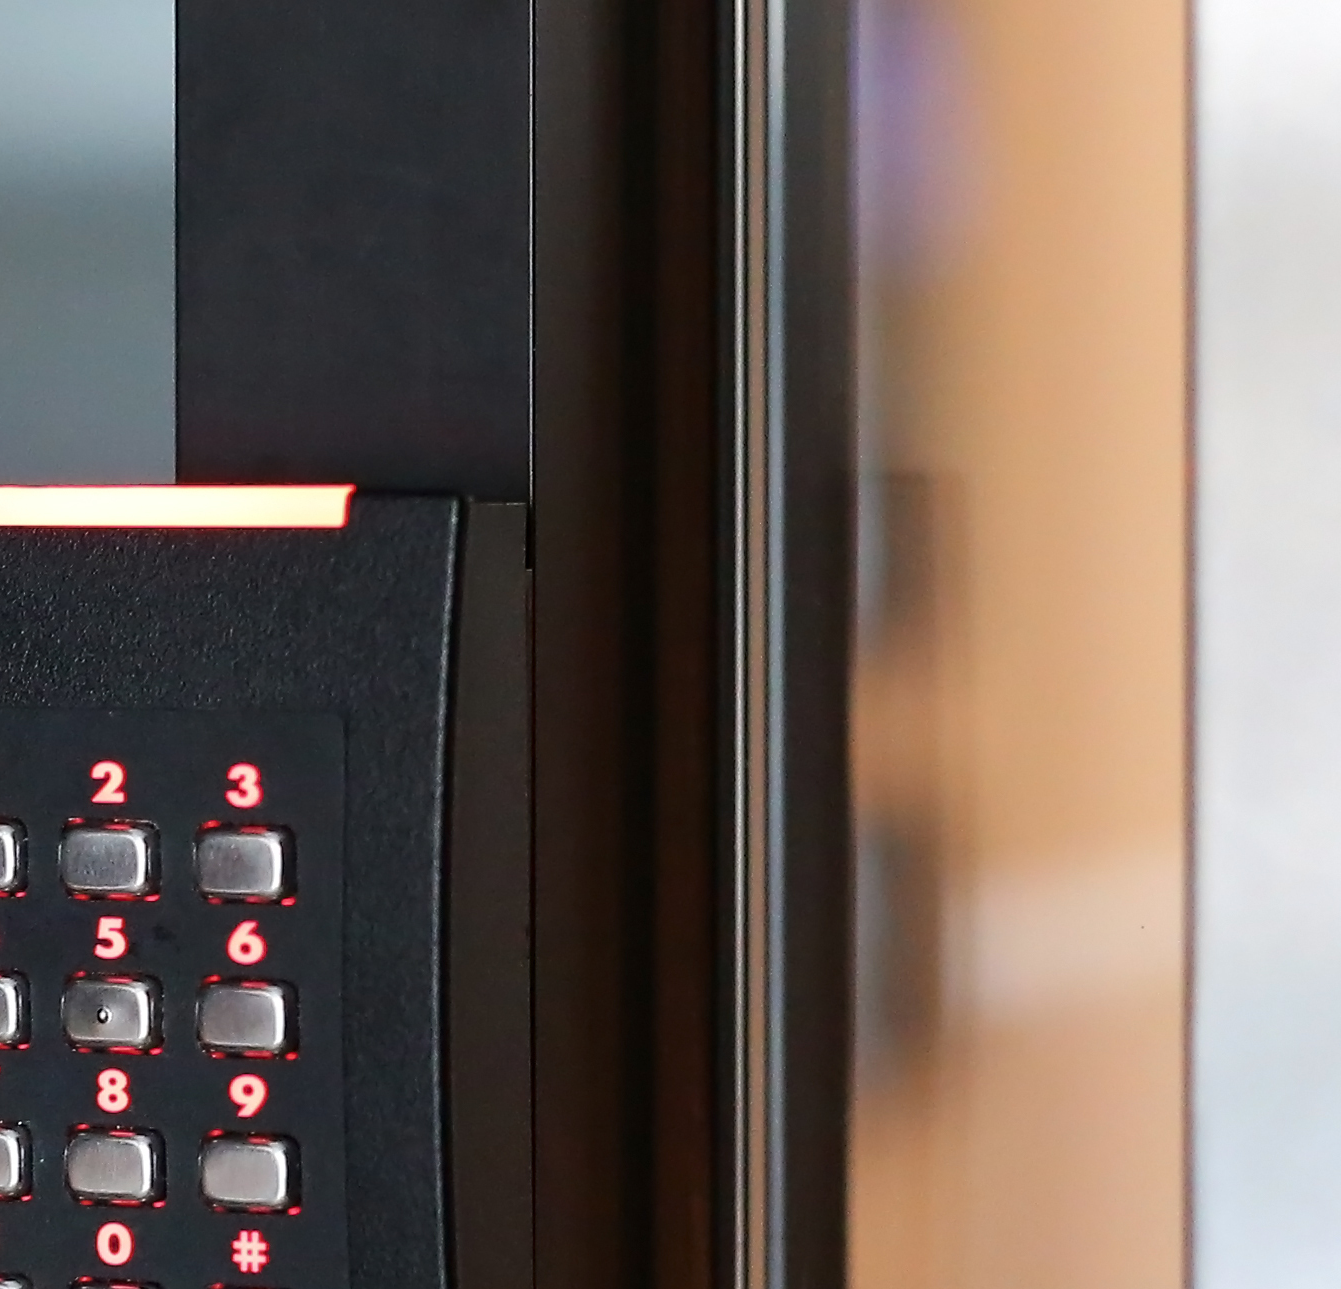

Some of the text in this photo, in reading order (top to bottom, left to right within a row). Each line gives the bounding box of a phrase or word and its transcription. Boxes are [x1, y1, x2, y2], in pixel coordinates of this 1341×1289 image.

[91, 761, 127, 803] 2
[226, 763, 263, 808] 3
[95, 917, 128, 959] 5
[227, 921, 266, 965] 6
[96, 1069, 131, 1113] 8
[229, 1074, 267, 1117] 9
[96, 1223, 134, 1266] 0
[231, 1230, 270, 1273] #
